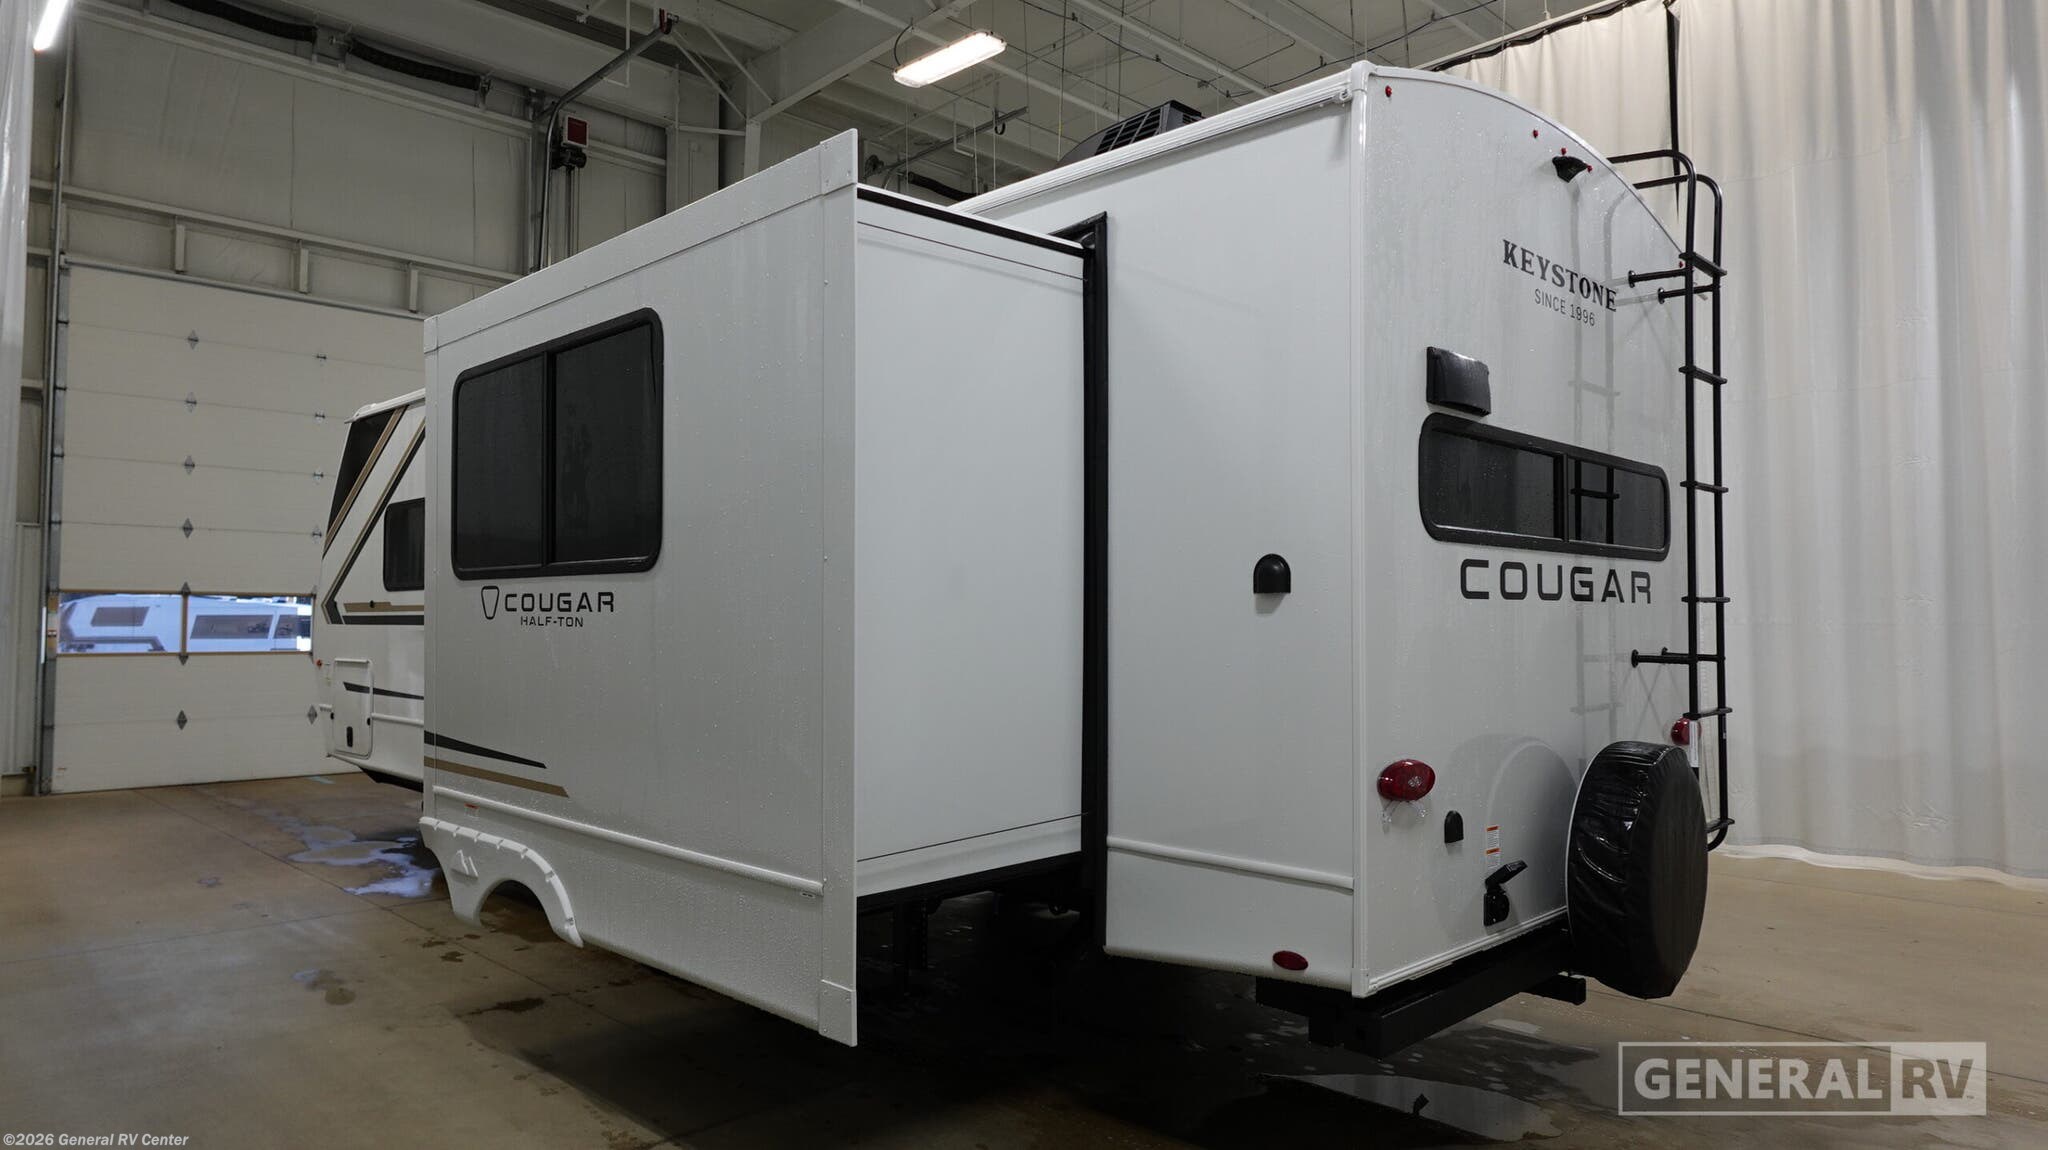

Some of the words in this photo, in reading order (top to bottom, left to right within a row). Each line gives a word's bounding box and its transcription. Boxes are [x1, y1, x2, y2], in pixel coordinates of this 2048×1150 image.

[1503, 239, 1617, 312] KEYSTONE
[1534, 288, 1567, 315] SINCE
[1570, 303, 1596, 327] 1996
[1460, 558, 1652, 604] COUGAR
[504, 591, 615, 613] COUGAR
[520, 615, 584, 628] HALF-TON
